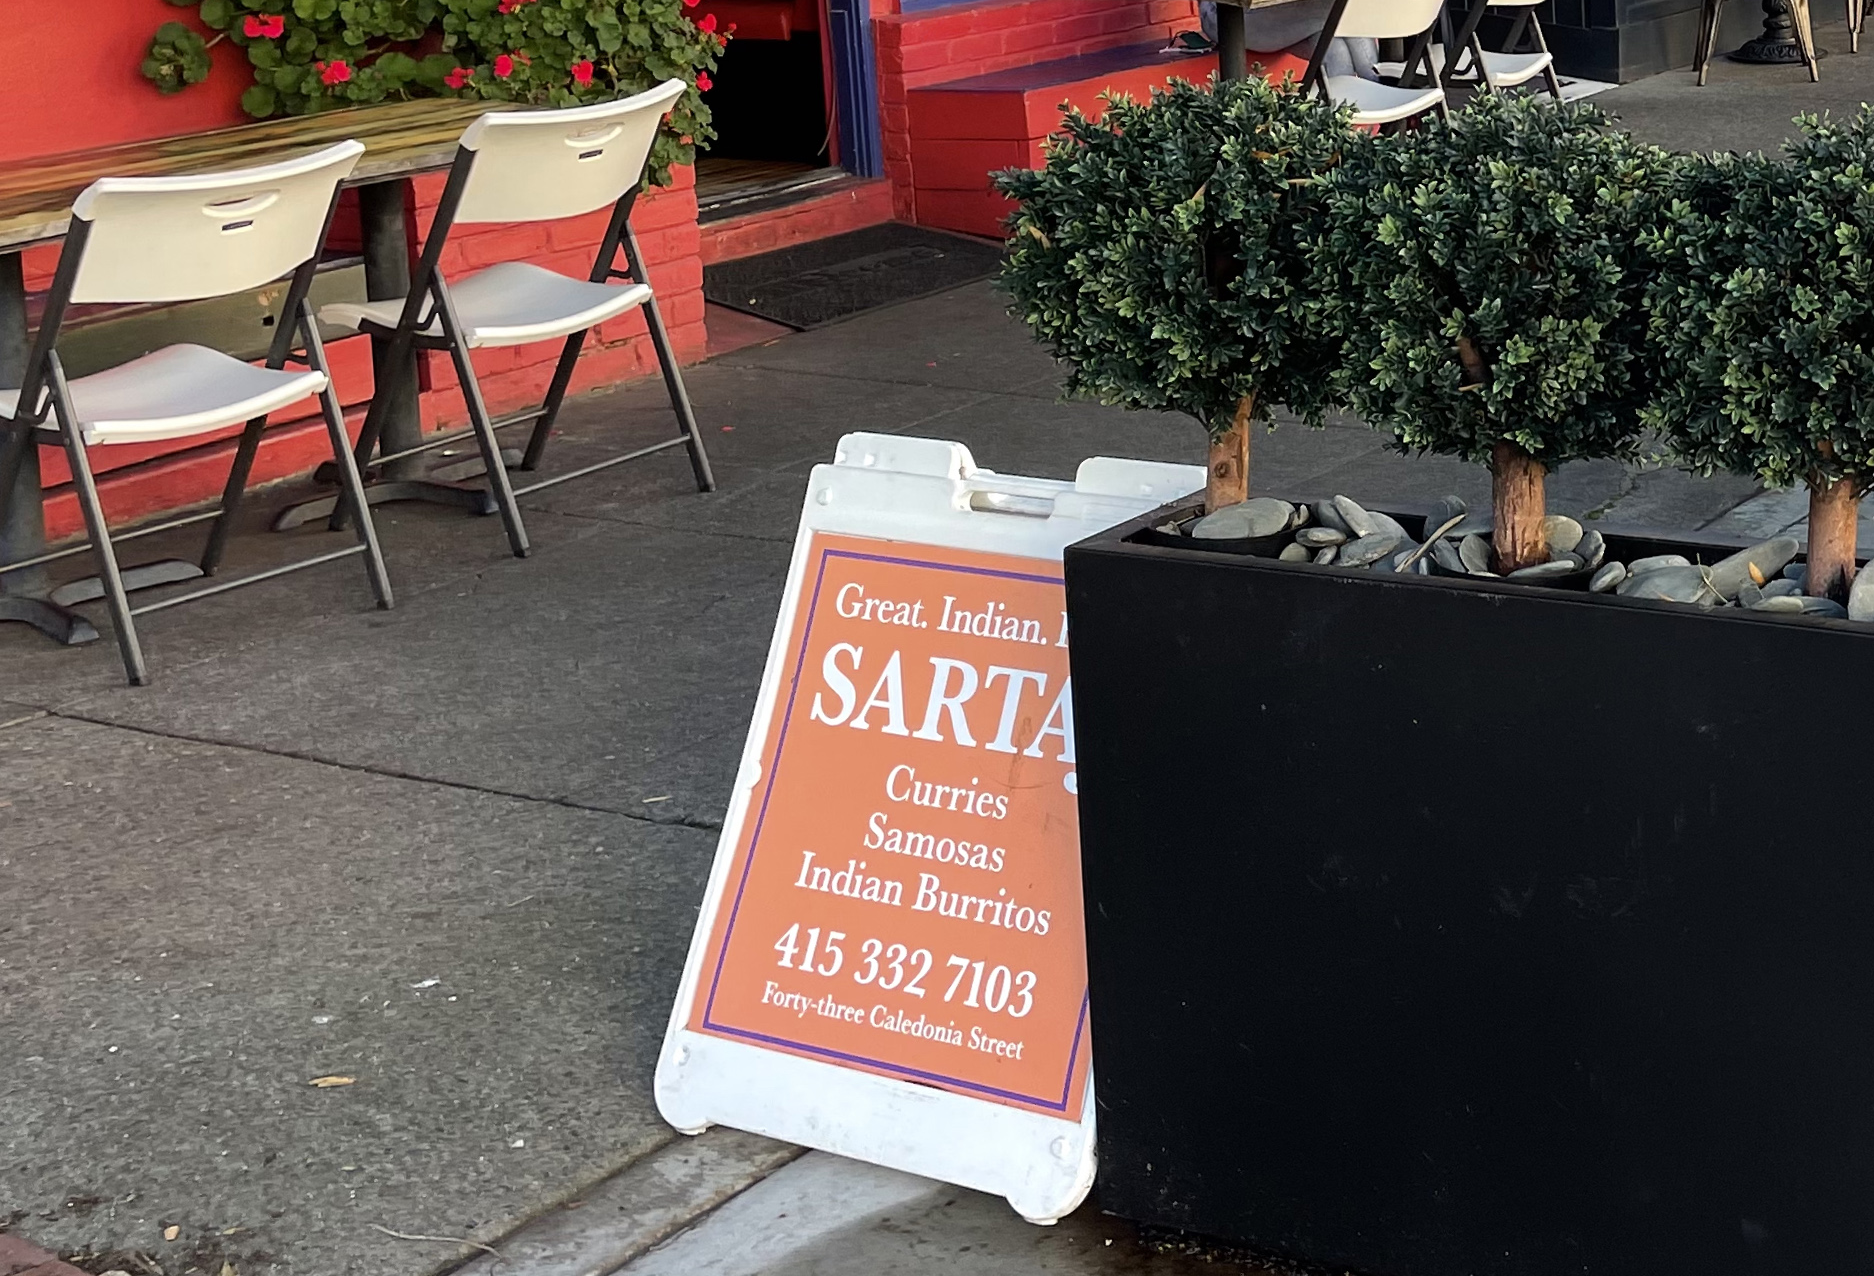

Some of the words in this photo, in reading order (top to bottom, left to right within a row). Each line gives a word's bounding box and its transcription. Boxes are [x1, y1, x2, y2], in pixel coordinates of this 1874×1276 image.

[835, 582, 928, 629] Great.
[937, 596, 1047, 646] Indian.
[810, 642, 1077, 772] SARTA
[886, 764, 1009, 820] Curries
[863, 812, 1006, 873] Samosas
[794, 850, 903, 906] Indian
[911, 873, 1051, 936] Burritos
[774, 923, 846, 977] 415
[853, 938, 933, 999] 332
[943, 954, 1037, 1017] 7103
[761, 981, 865, 1023] Forty-three
[870, 1004, 962, 1046] Caledonia
[967, 1026, 1025, 1060] Street
